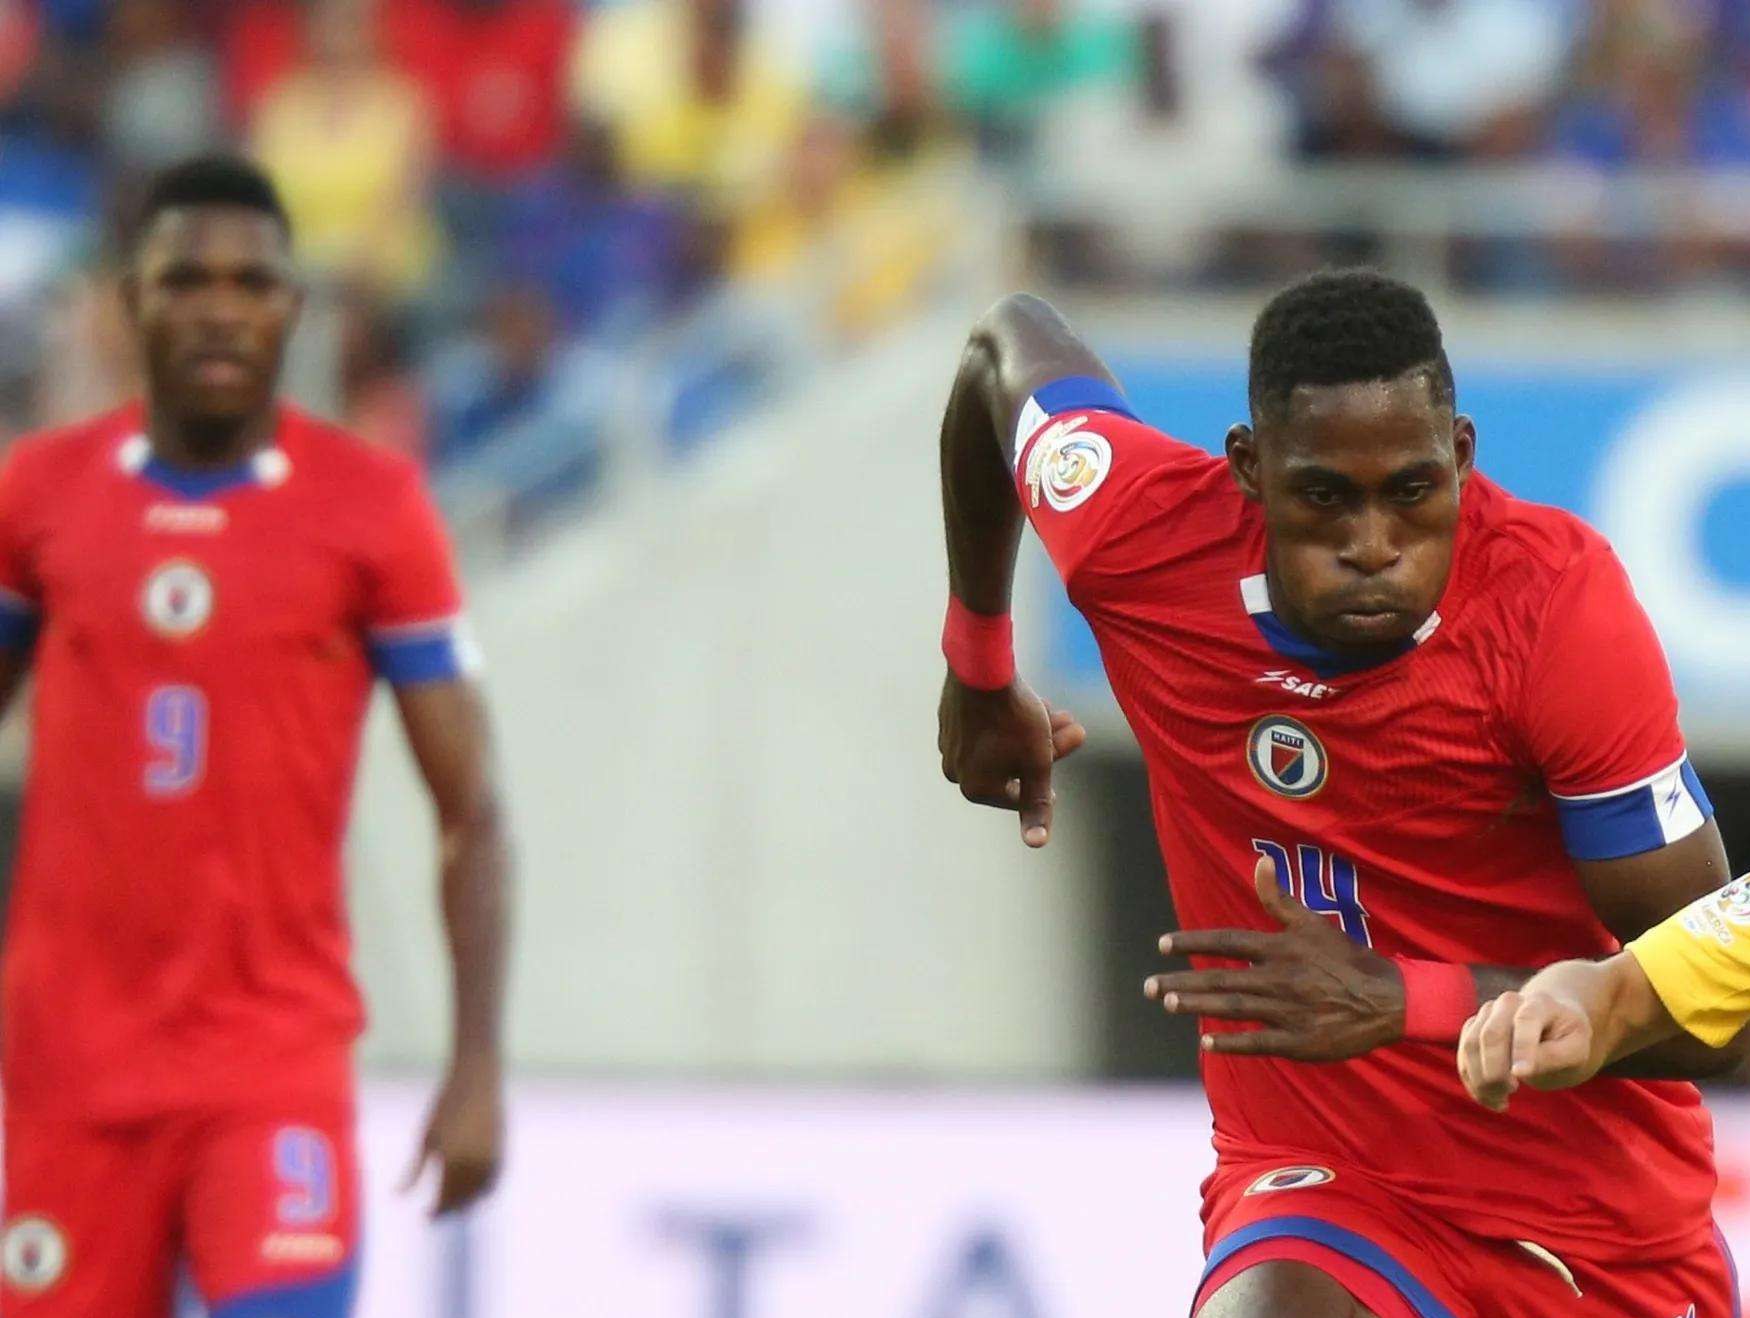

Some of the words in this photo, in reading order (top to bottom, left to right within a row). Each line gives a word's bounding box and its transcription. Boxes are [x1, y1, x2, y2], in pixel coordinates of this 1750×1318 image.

[144, 684, 207, 796] 9
[1281, 675, 1338, 699] SAE
[1251, 838, 1373, 950] 14
[273, 1125, 335, 1225] 9
